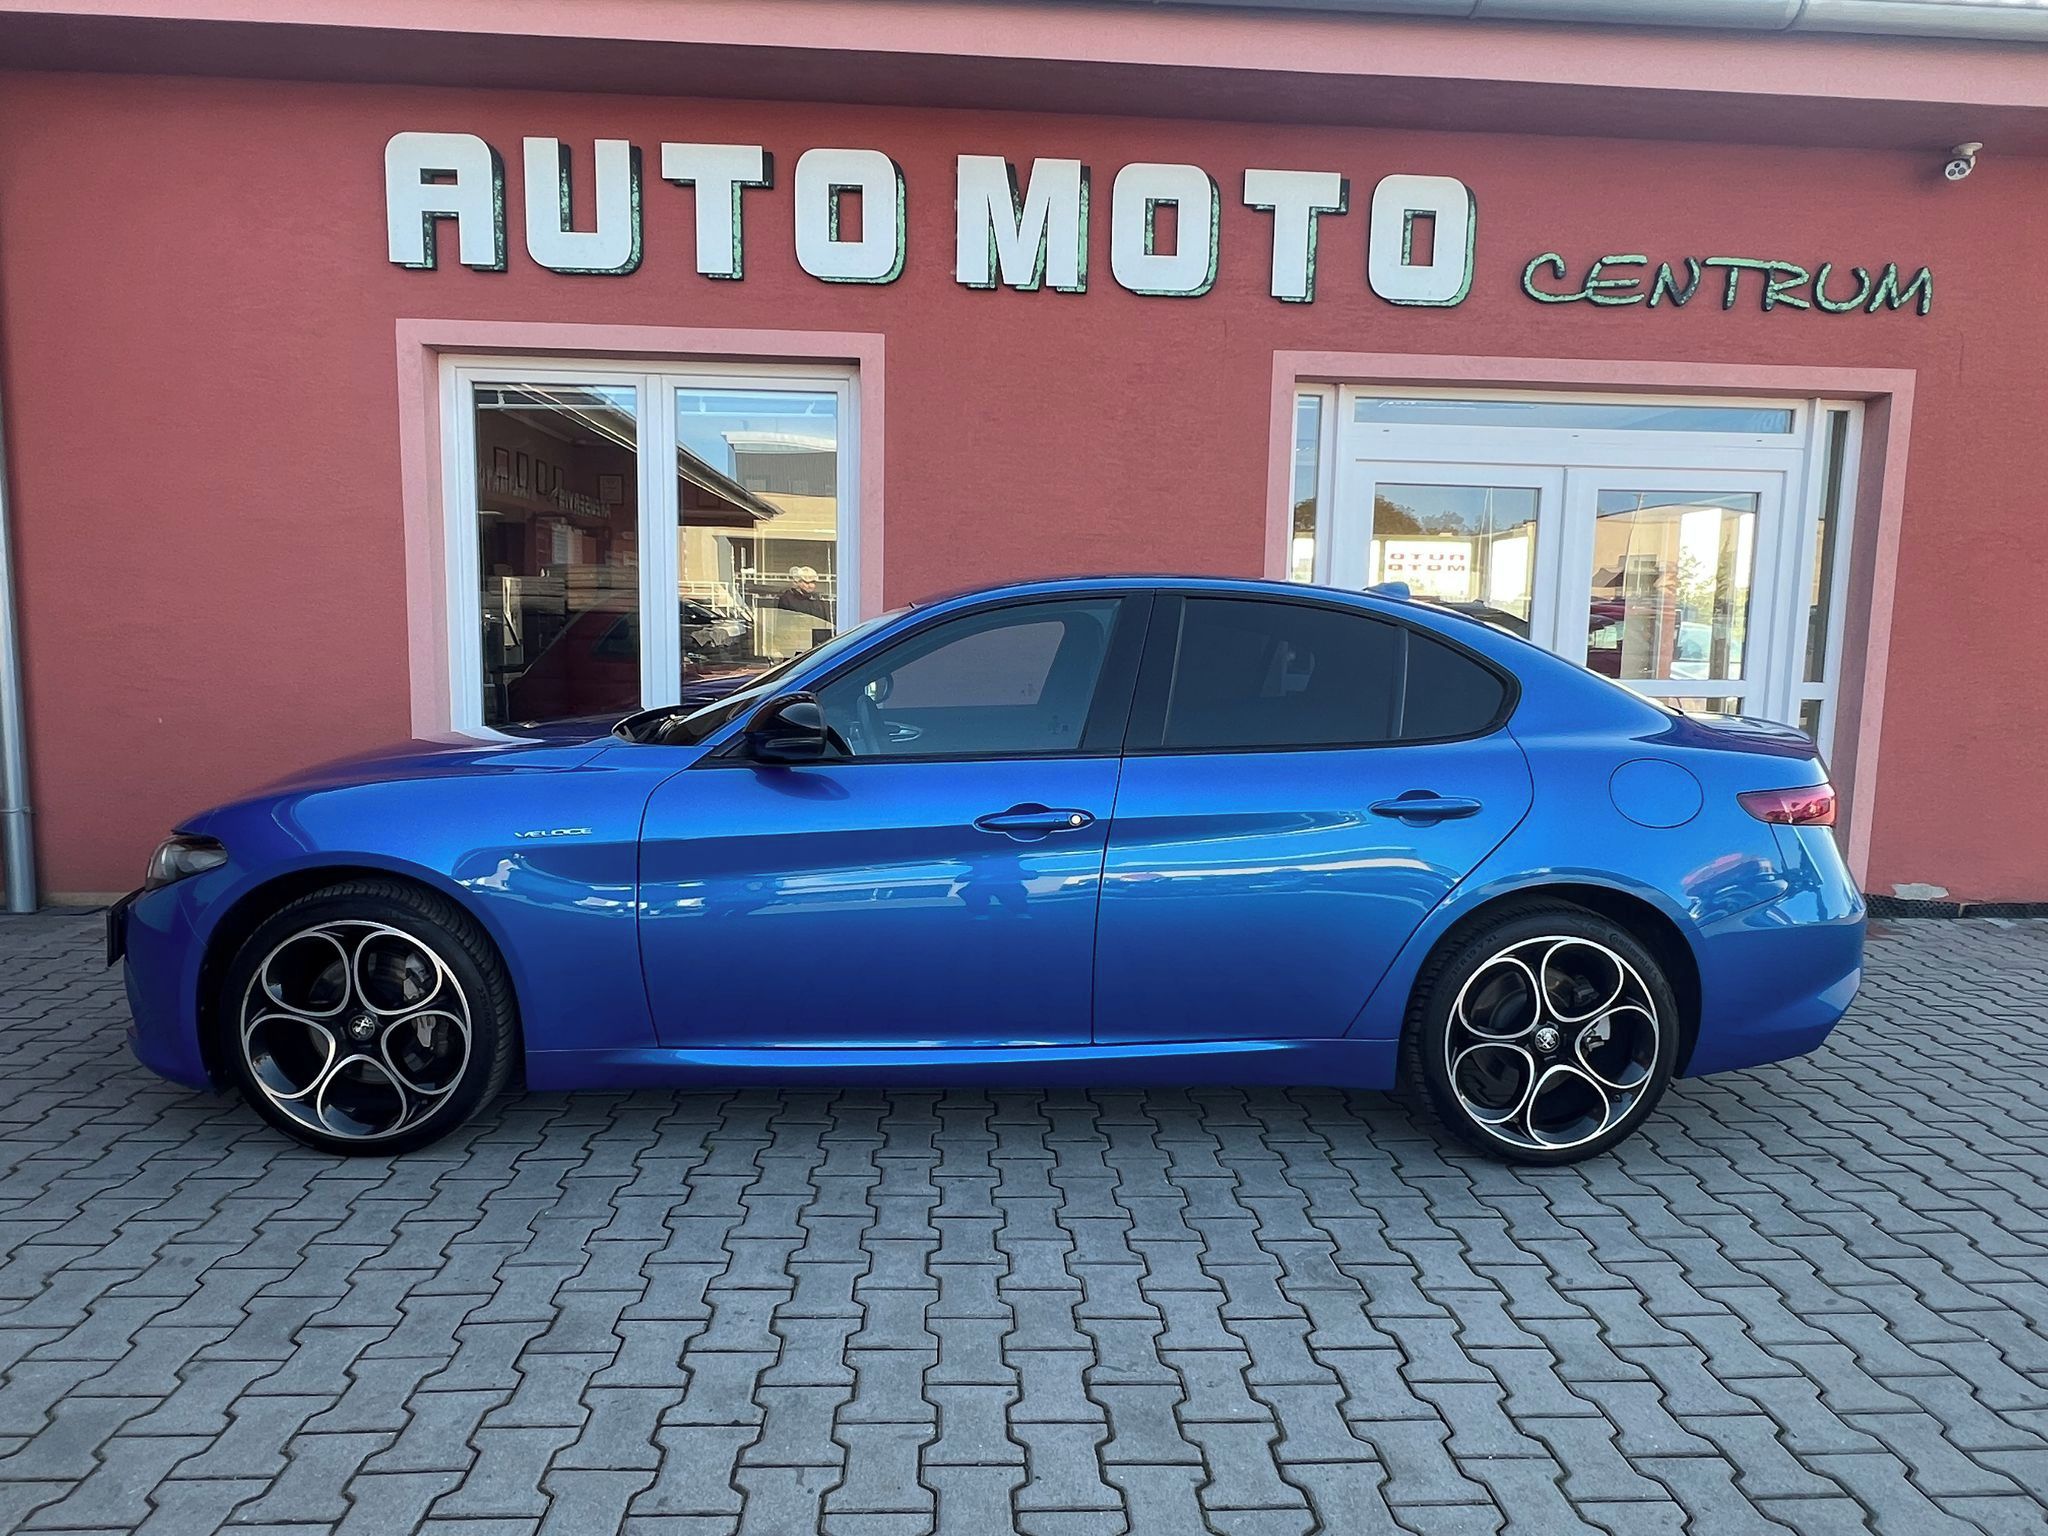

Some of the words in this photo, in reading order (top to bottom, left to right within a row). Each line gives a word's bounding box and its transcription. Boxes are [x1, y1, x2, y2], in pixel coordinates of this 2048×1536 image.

[384, 131, 907, 285] AUTO
[955, 154, 1476, 307] MOTO
[1521, 252, 1933, 315] CENTRUM
[514, 827, 592, 838] VELOCE
